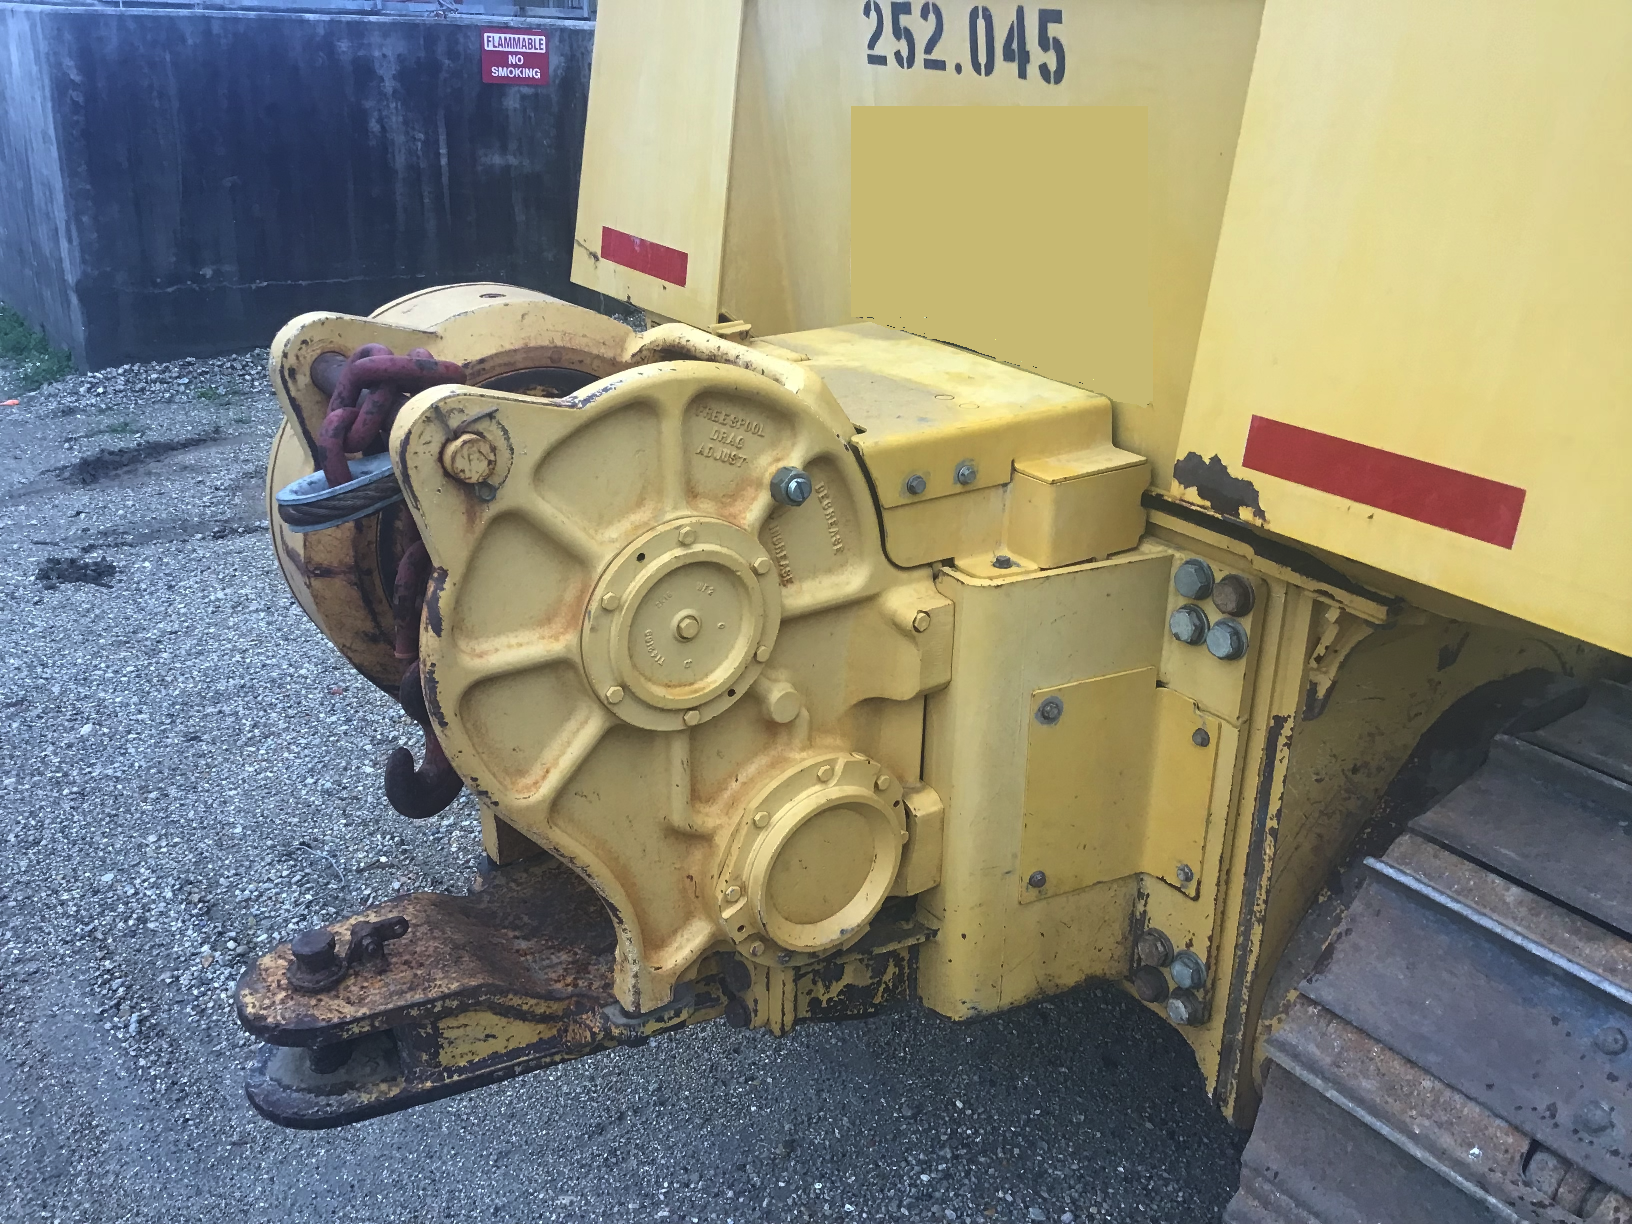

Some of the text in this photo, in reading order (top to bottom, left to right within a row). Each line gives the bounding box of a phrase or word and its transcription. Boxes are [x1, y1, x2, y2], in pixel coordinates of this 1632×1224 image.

[486, 35, 544, 51] FLAMMABLE
[862, 0, 1066, 86] 252.045
[508, 54, 524, 65] NO
[491, 66, 541, 79] SMOKING
[709, 427, 745, 450] DRAG
[695, 442, 749, 469] ADJUST
[814, 481, 845, 556] DECREASE
